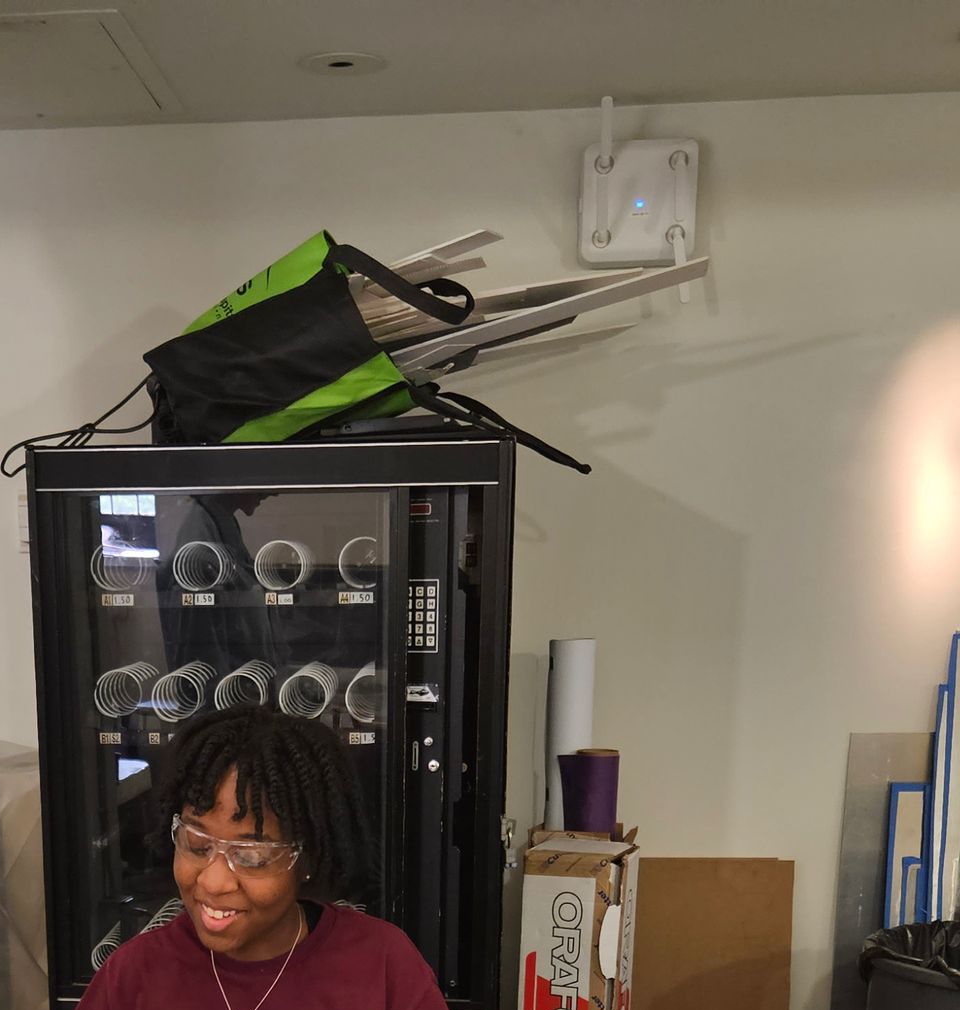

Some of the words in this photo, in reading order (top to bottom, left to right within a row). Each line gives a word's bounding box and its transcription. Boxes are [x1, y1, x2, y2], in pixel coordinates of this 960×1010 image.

[113, 595, 131, 605] 1.50
[196, 594, 213, 604] 1.50
[352, 593, 371, 603] 1.50
